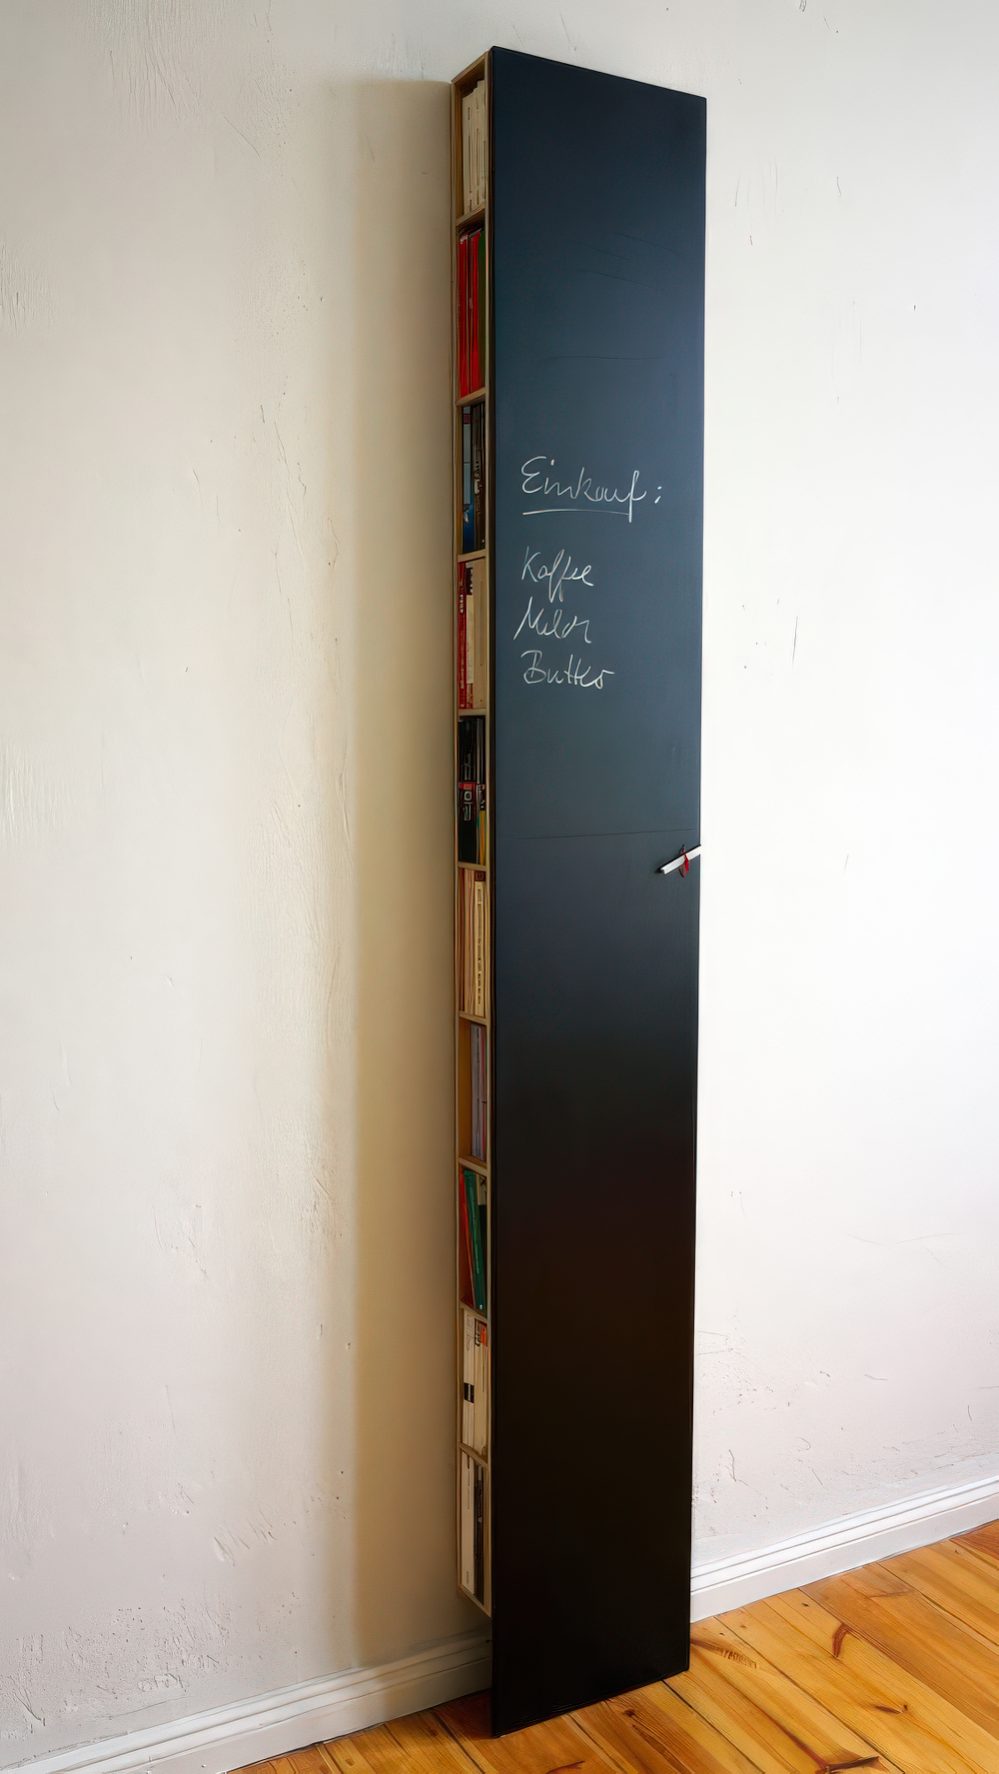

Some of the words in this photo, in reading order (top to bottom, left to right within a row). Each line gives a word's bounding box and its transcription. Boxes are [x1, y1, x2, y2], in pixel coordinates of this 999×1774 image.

[520, 545, 595, 603] Kaffee
[512, 595, 593, 644] Milch
[520, 649, 616, 690] Butter
